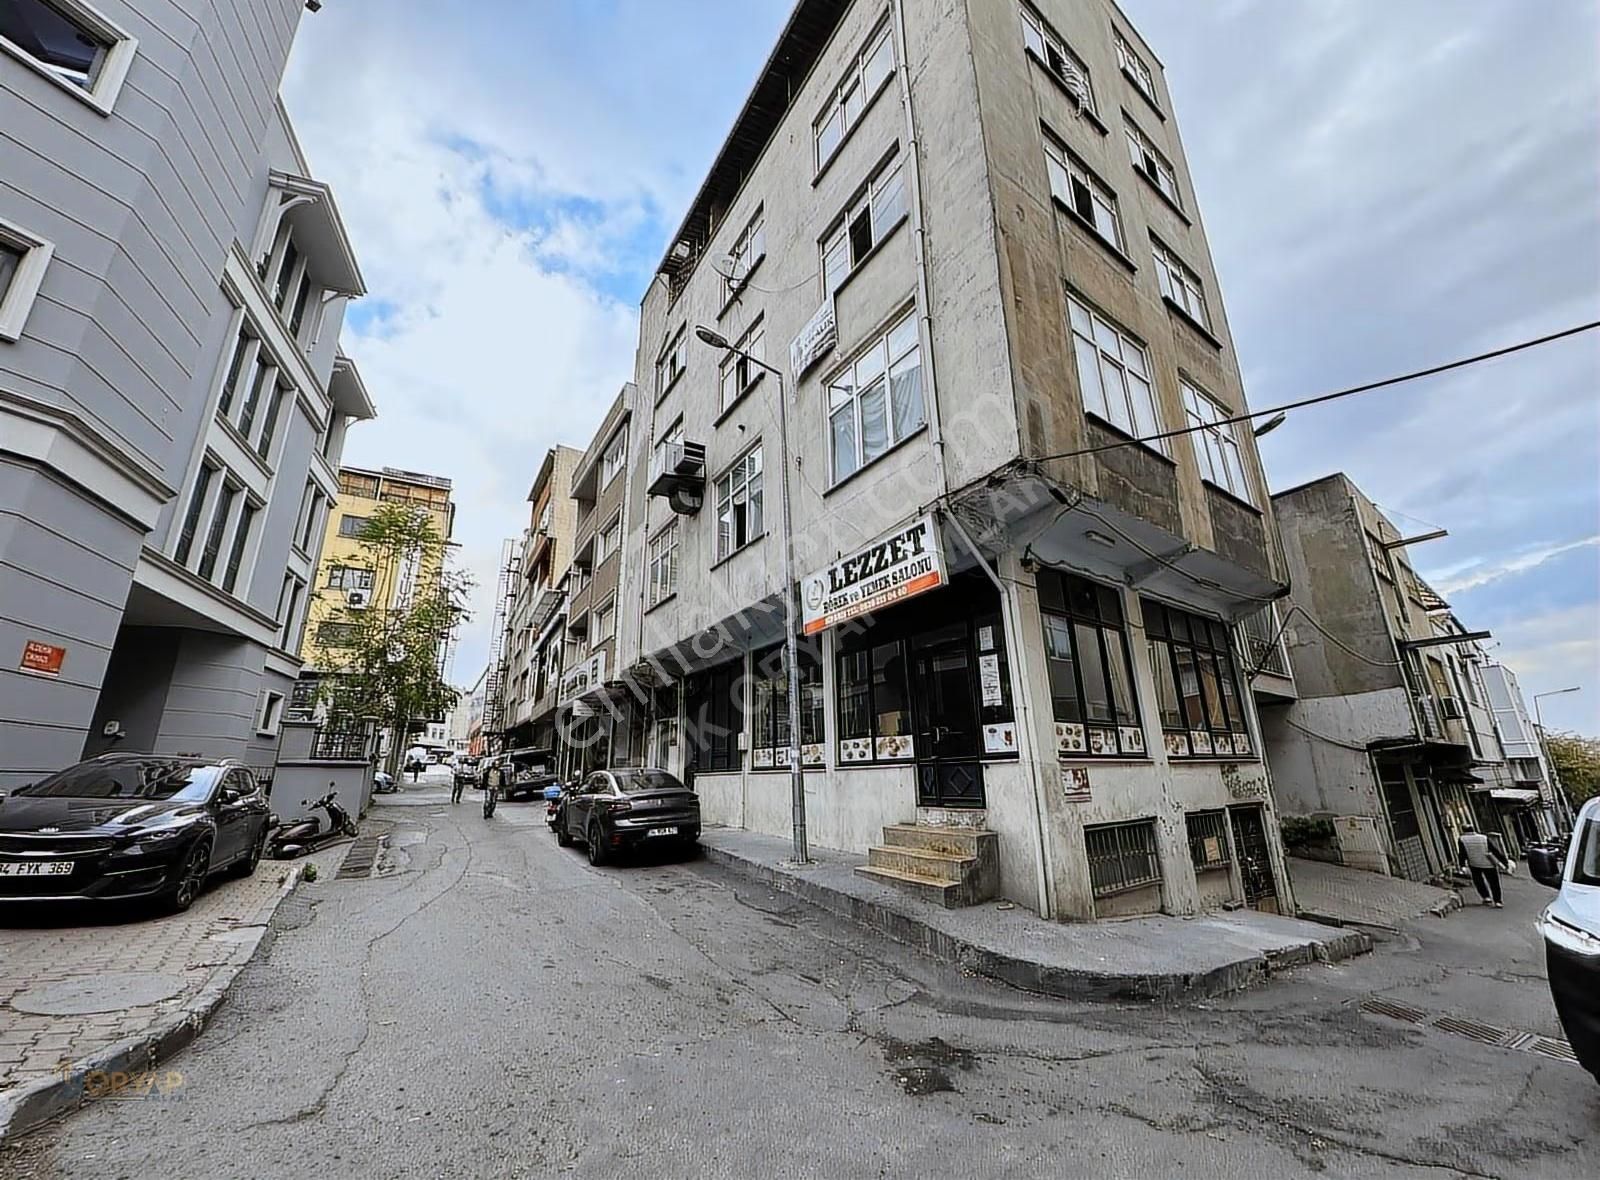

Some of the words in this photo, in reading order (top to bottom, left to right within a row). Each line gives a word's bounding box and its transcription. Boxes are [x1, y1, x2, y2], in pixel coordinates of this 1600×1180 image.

[828, 522, 926, 594] LEZZET
[860, 574, 891, 598] YEMEK
[891, 556, 932, 585] SALONU
[16, 862, 42, 874] FYK
[48, 862, 72, 874] 369
